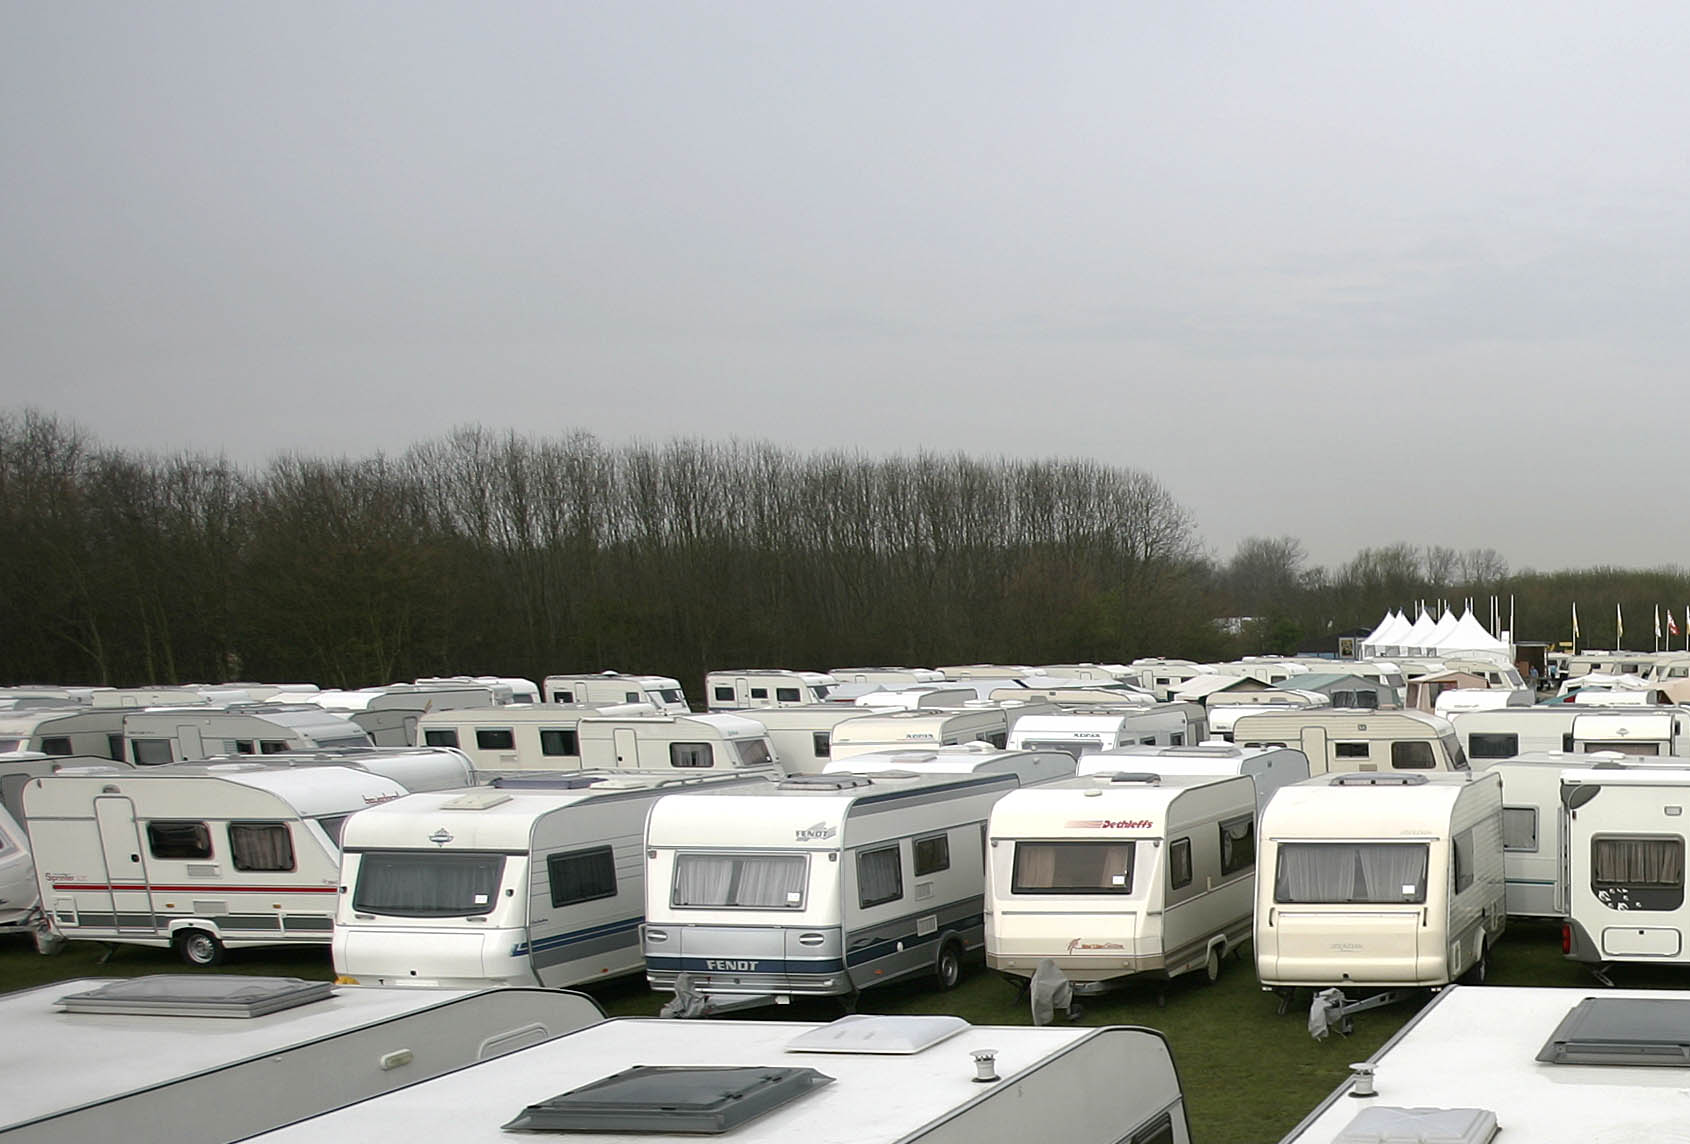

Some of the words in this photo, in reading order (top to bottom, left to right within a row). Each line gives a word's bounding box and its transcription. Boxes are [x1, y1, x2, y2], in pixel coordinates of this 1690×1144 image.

[1102, 820, 1153, 829] Dethleffs
[796, 830, 829, 839] FENDT
[706, 960, 759, 971] FENDT
